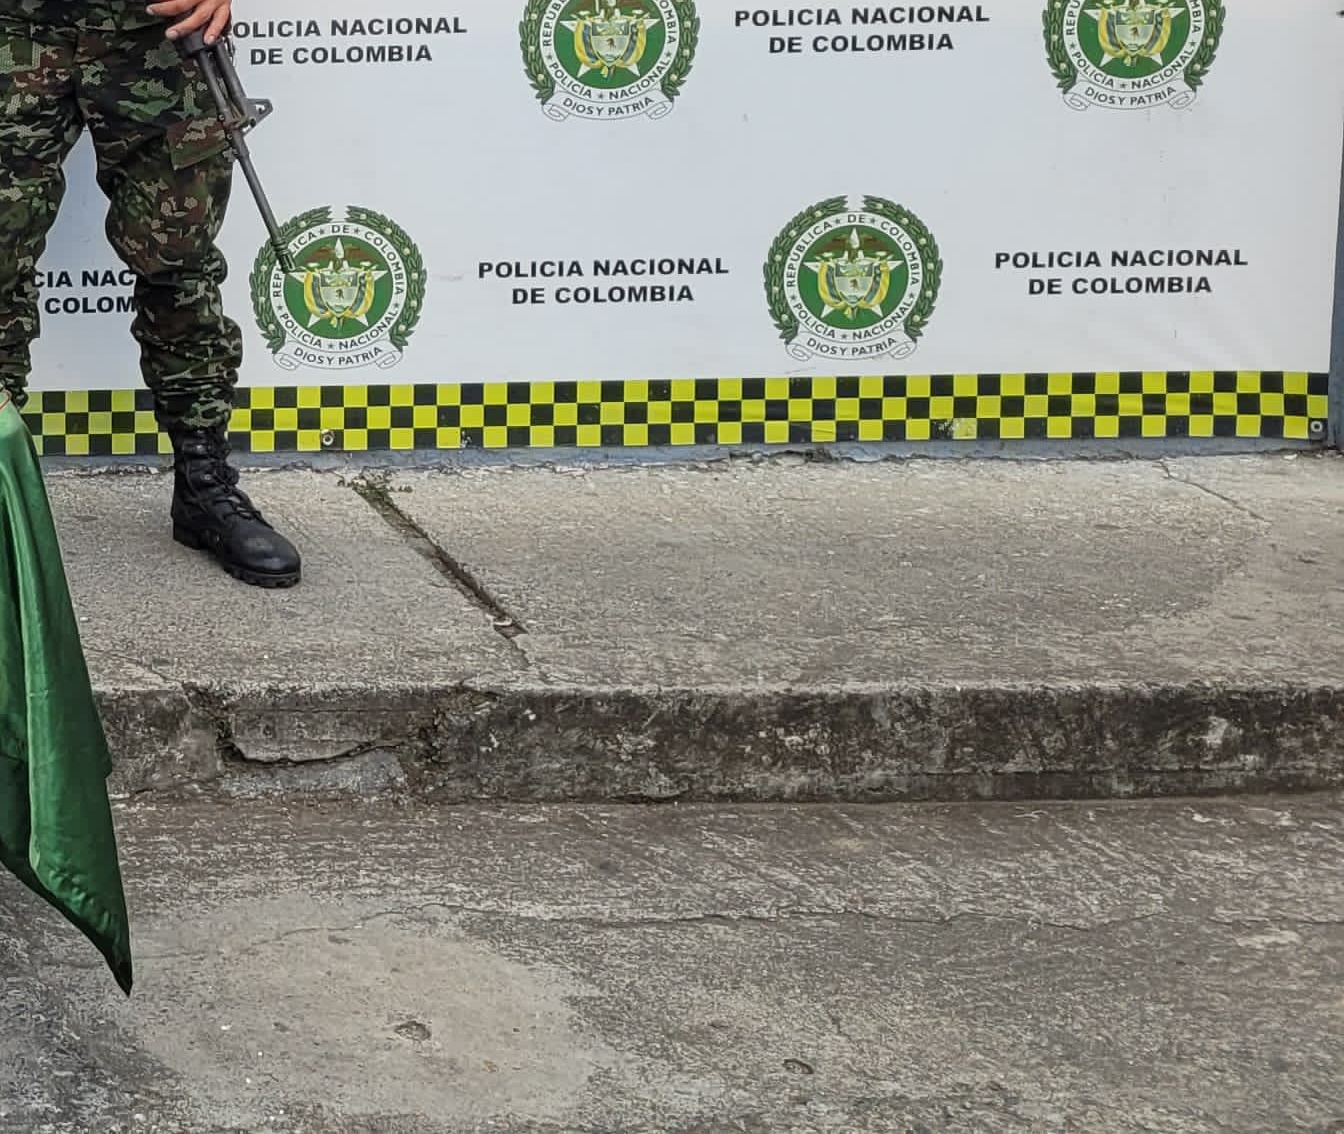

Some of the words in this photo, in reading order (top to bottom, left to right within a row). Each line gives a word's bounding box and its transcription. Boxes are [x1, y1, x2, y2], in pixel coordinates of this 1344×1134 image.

[735, 9, 841, 26] POLICIA
[852, 6, 989, 24] NACIONAL
[233, 20, 320, 38] OLICIA
[331, 17, 467, 36] NACIONAL
[769, 37, 802, 53] DE
[813, 34, 953, 52] COLOMBIA
[251, 48, 283, 65] DE
[293, 45, 432, 64] COLOMBIA
[847, 214, 865, 222] DE
[878, 221, 921, 285] COLOMBIA
[996, 251, 1101, 268] POLICIA
[1112, 250, 1248, 266] NACIONAL
[479, 261, 584, 278] POLICIA
[594, 258, 728, 276] NACIONAL
[512, 288, 545, 304] DE
[555, 285, 693, 303] COLOMBIA
[1029, 279, 1062, 295] DE
[1072, 277, 1212, 294] COLOMBIA
[853, 299, 912, 339] NACIONAL
[851, 337, 896, 355] PATRIA
